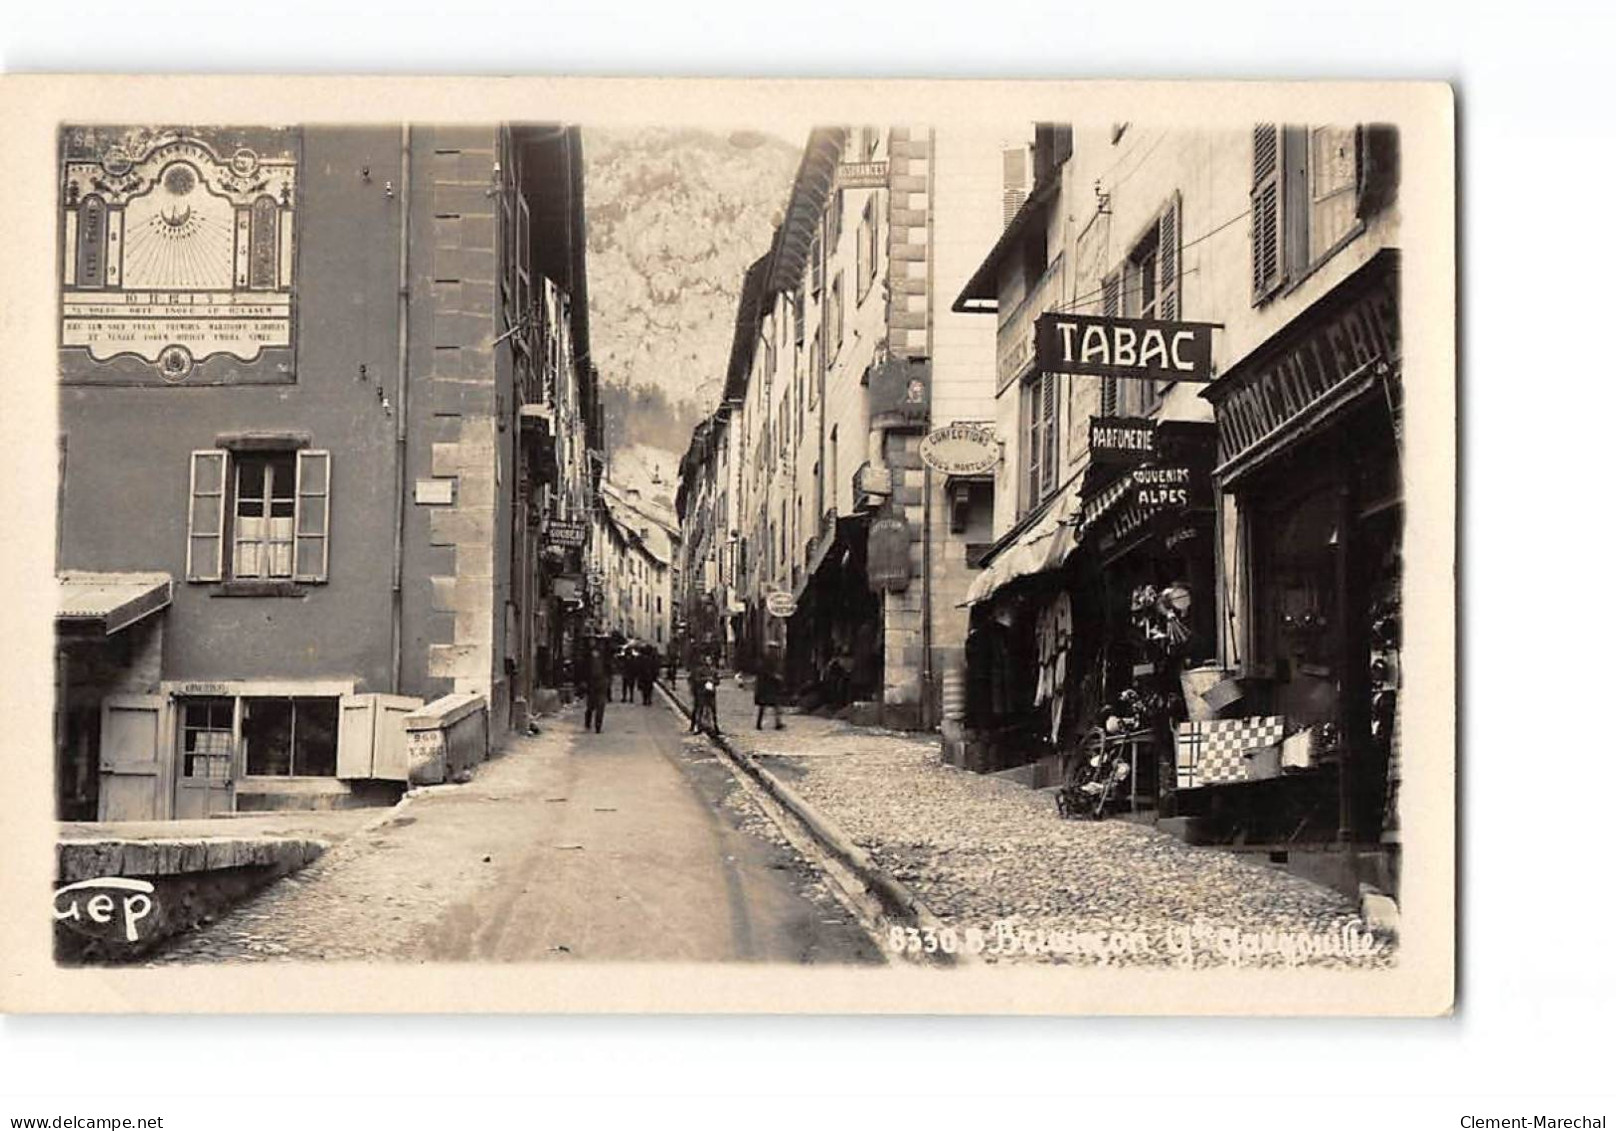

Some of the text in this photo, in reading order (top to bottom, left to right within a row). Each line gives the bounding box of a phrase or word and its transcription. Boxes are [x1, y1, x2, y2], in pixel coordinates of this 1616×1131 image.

[1057, 322, 1196, 371] TABAC
[928, 428, 990, 448] CONFECTIONS
[1092, 427, 1154, 451] PARFUMERIE
[1133, 468, 1189, 484] SOUVENIRS
[1138, 489, 1187, 507] ALPES
